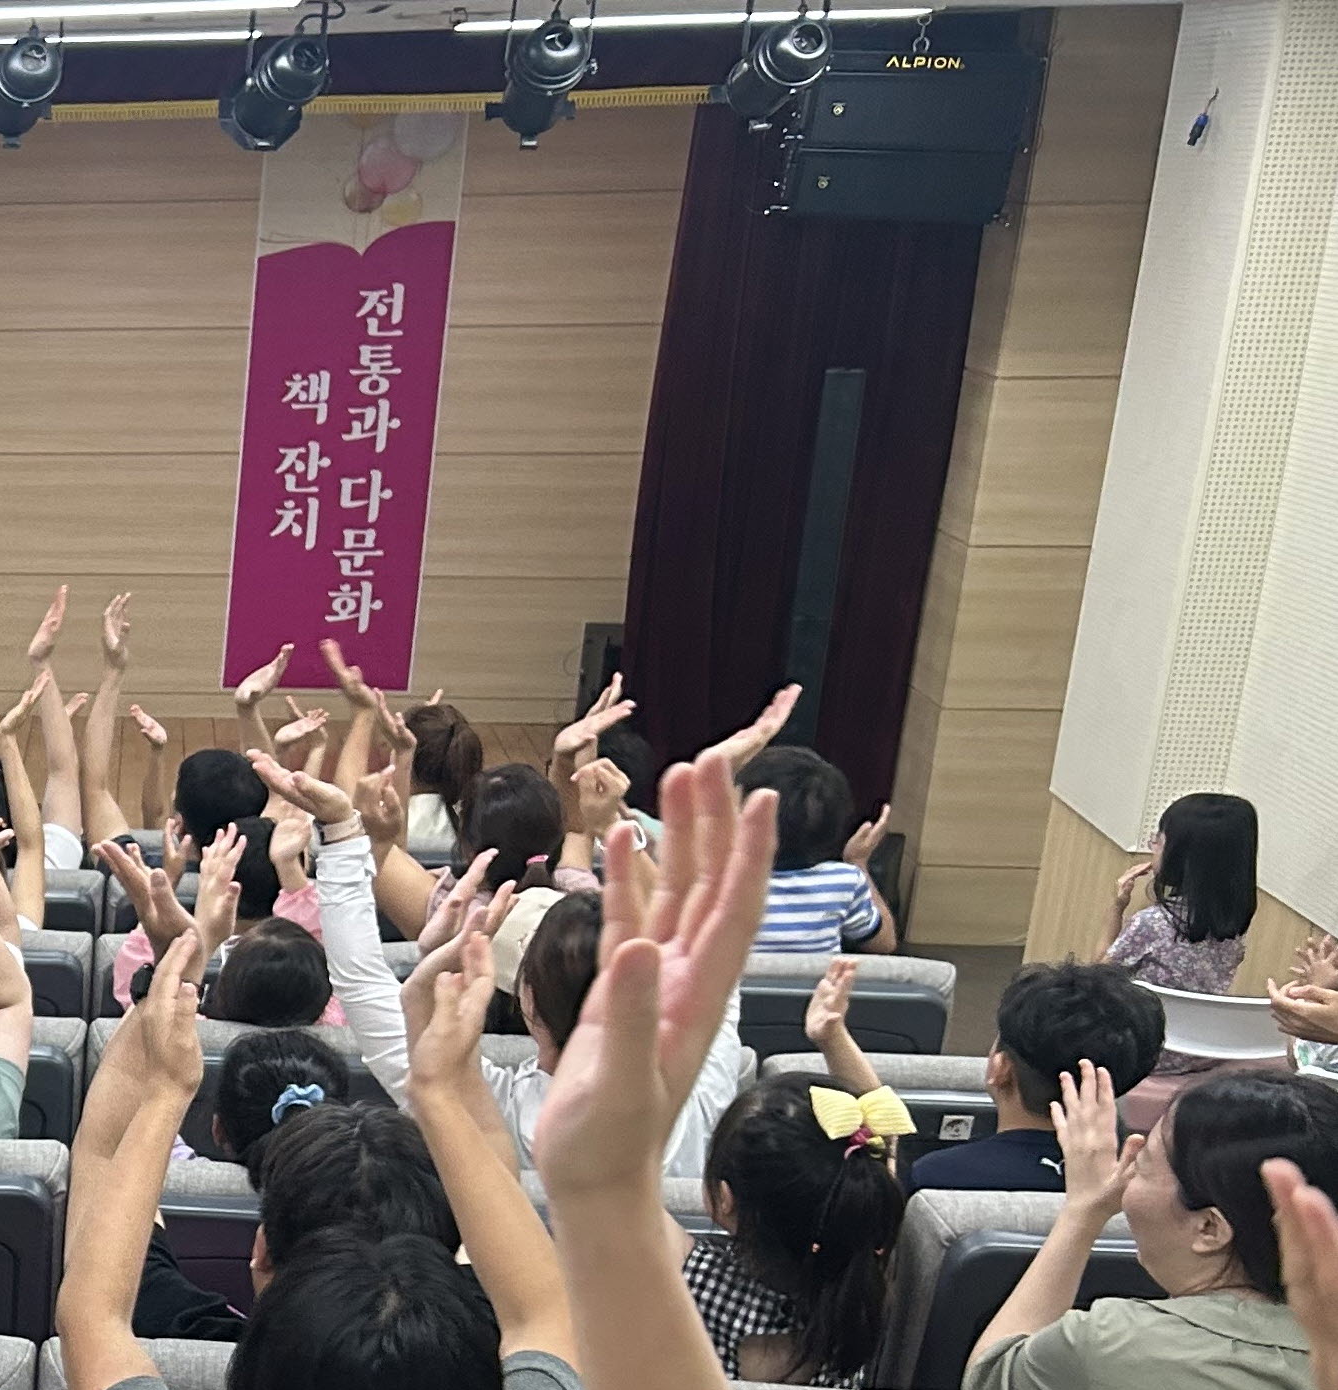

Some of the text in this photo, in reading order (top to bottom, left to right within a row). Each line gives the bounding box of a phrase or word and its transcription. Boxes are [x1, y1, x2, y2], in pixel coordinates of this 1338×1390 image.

[885, 55, 962, 69] ALPION
[269, 369, 333, 551] 책 잔치
[323, 282, 406, 634] 전통과 다문화
